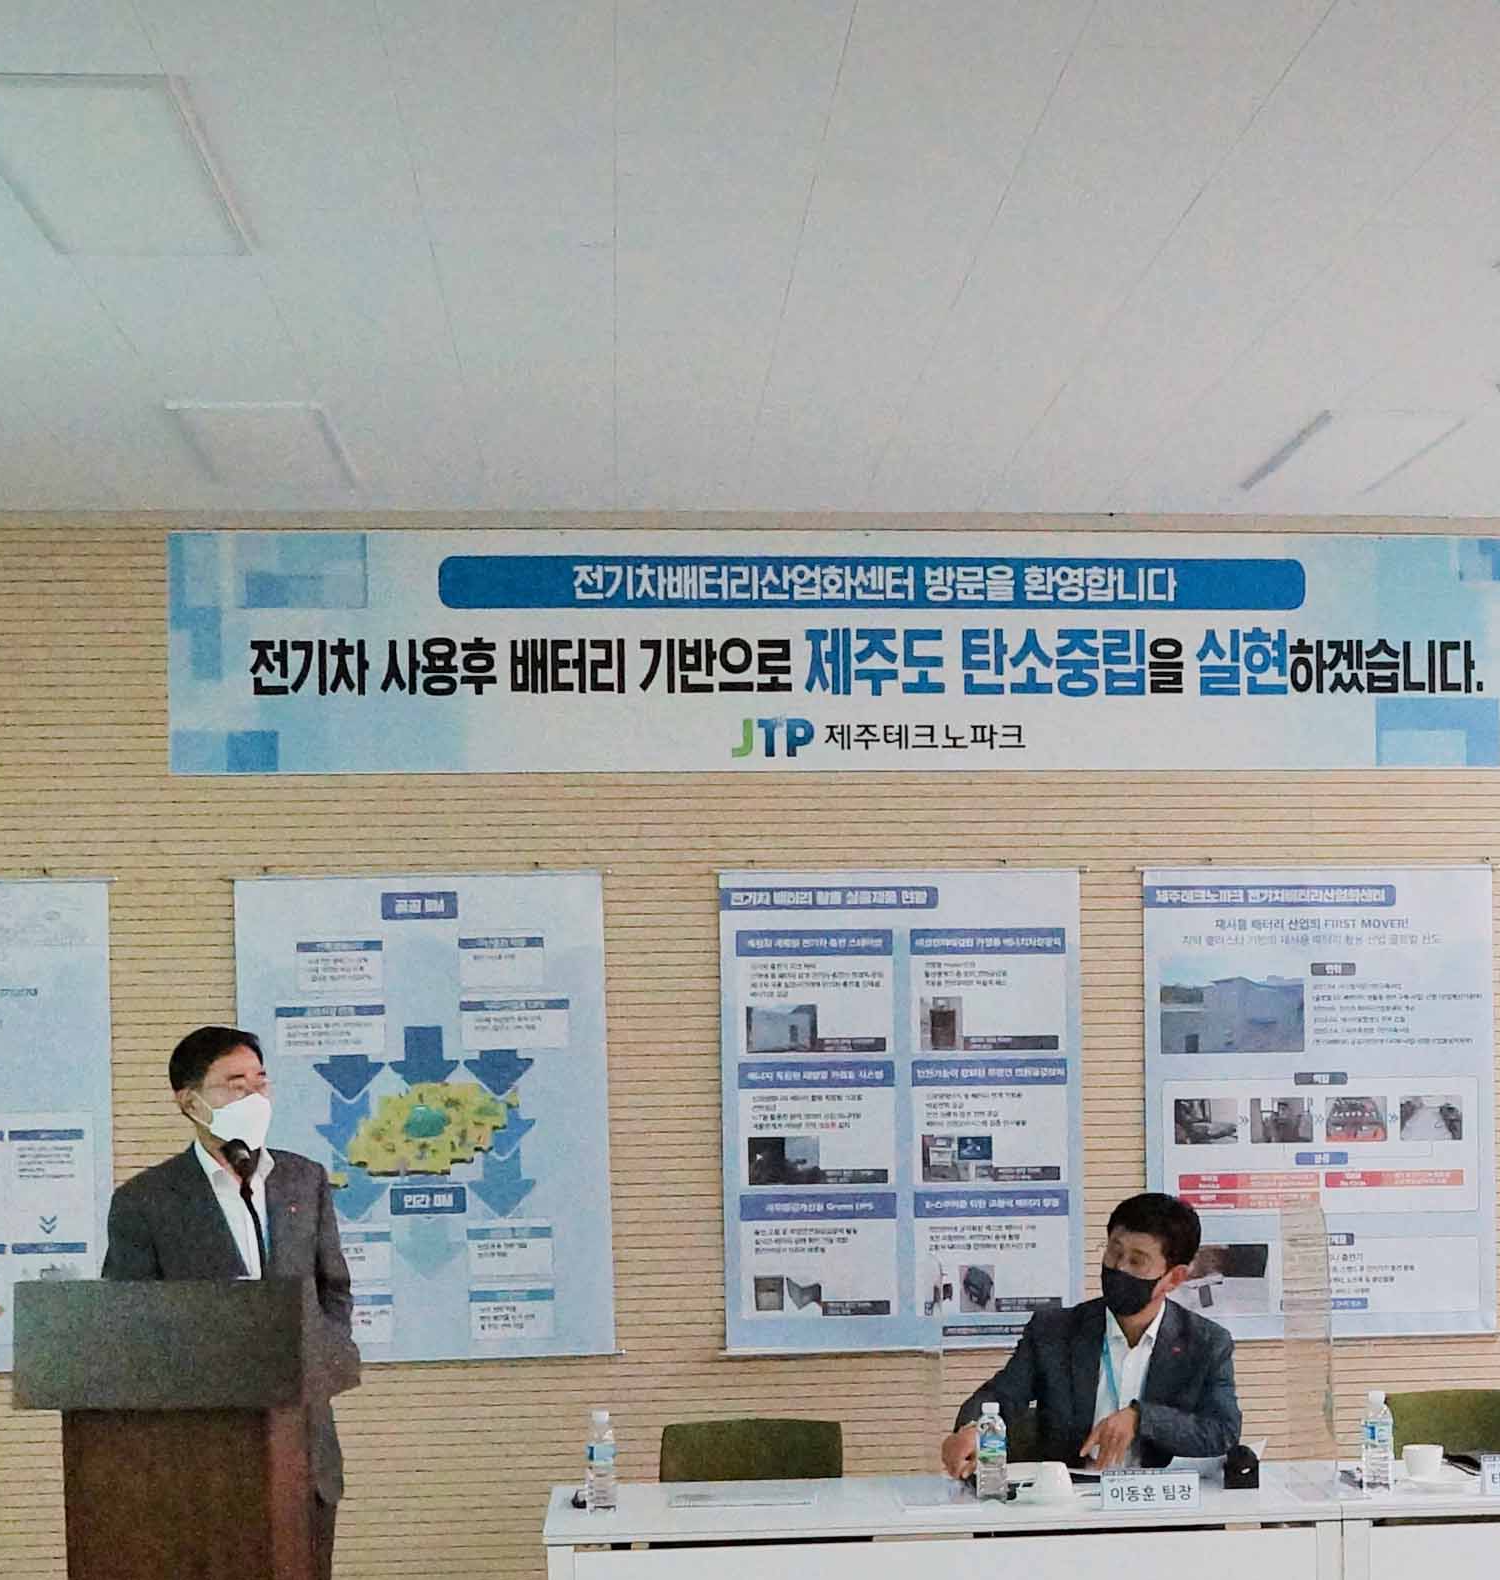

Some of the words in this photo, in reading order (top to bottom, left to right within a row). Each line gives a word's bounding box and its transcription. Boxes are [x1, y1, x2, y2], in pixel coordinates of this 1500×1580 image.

[572, 564, 915, 602] 전기차배터리산업화센터
[923, 565, 1015, 602] 방문을
[1023, 565, 1177, 603] 환영합니다
[249, 638, 369, 697] 전기차
[380, 636, 498, 697] 사용후
[509, 637, 626, 696] 배터리
[639, 637, 793, 696] 기반으로
[804, 627, 945, 698] 제주도
[960, 627, 1185, 698] 탄소중립을
[1196, 627, 1485, 698] 실현하겠습니다.
[731, 717, 815, 759] JTP
[824, 722, 1027, 752] 제주테크노파크
